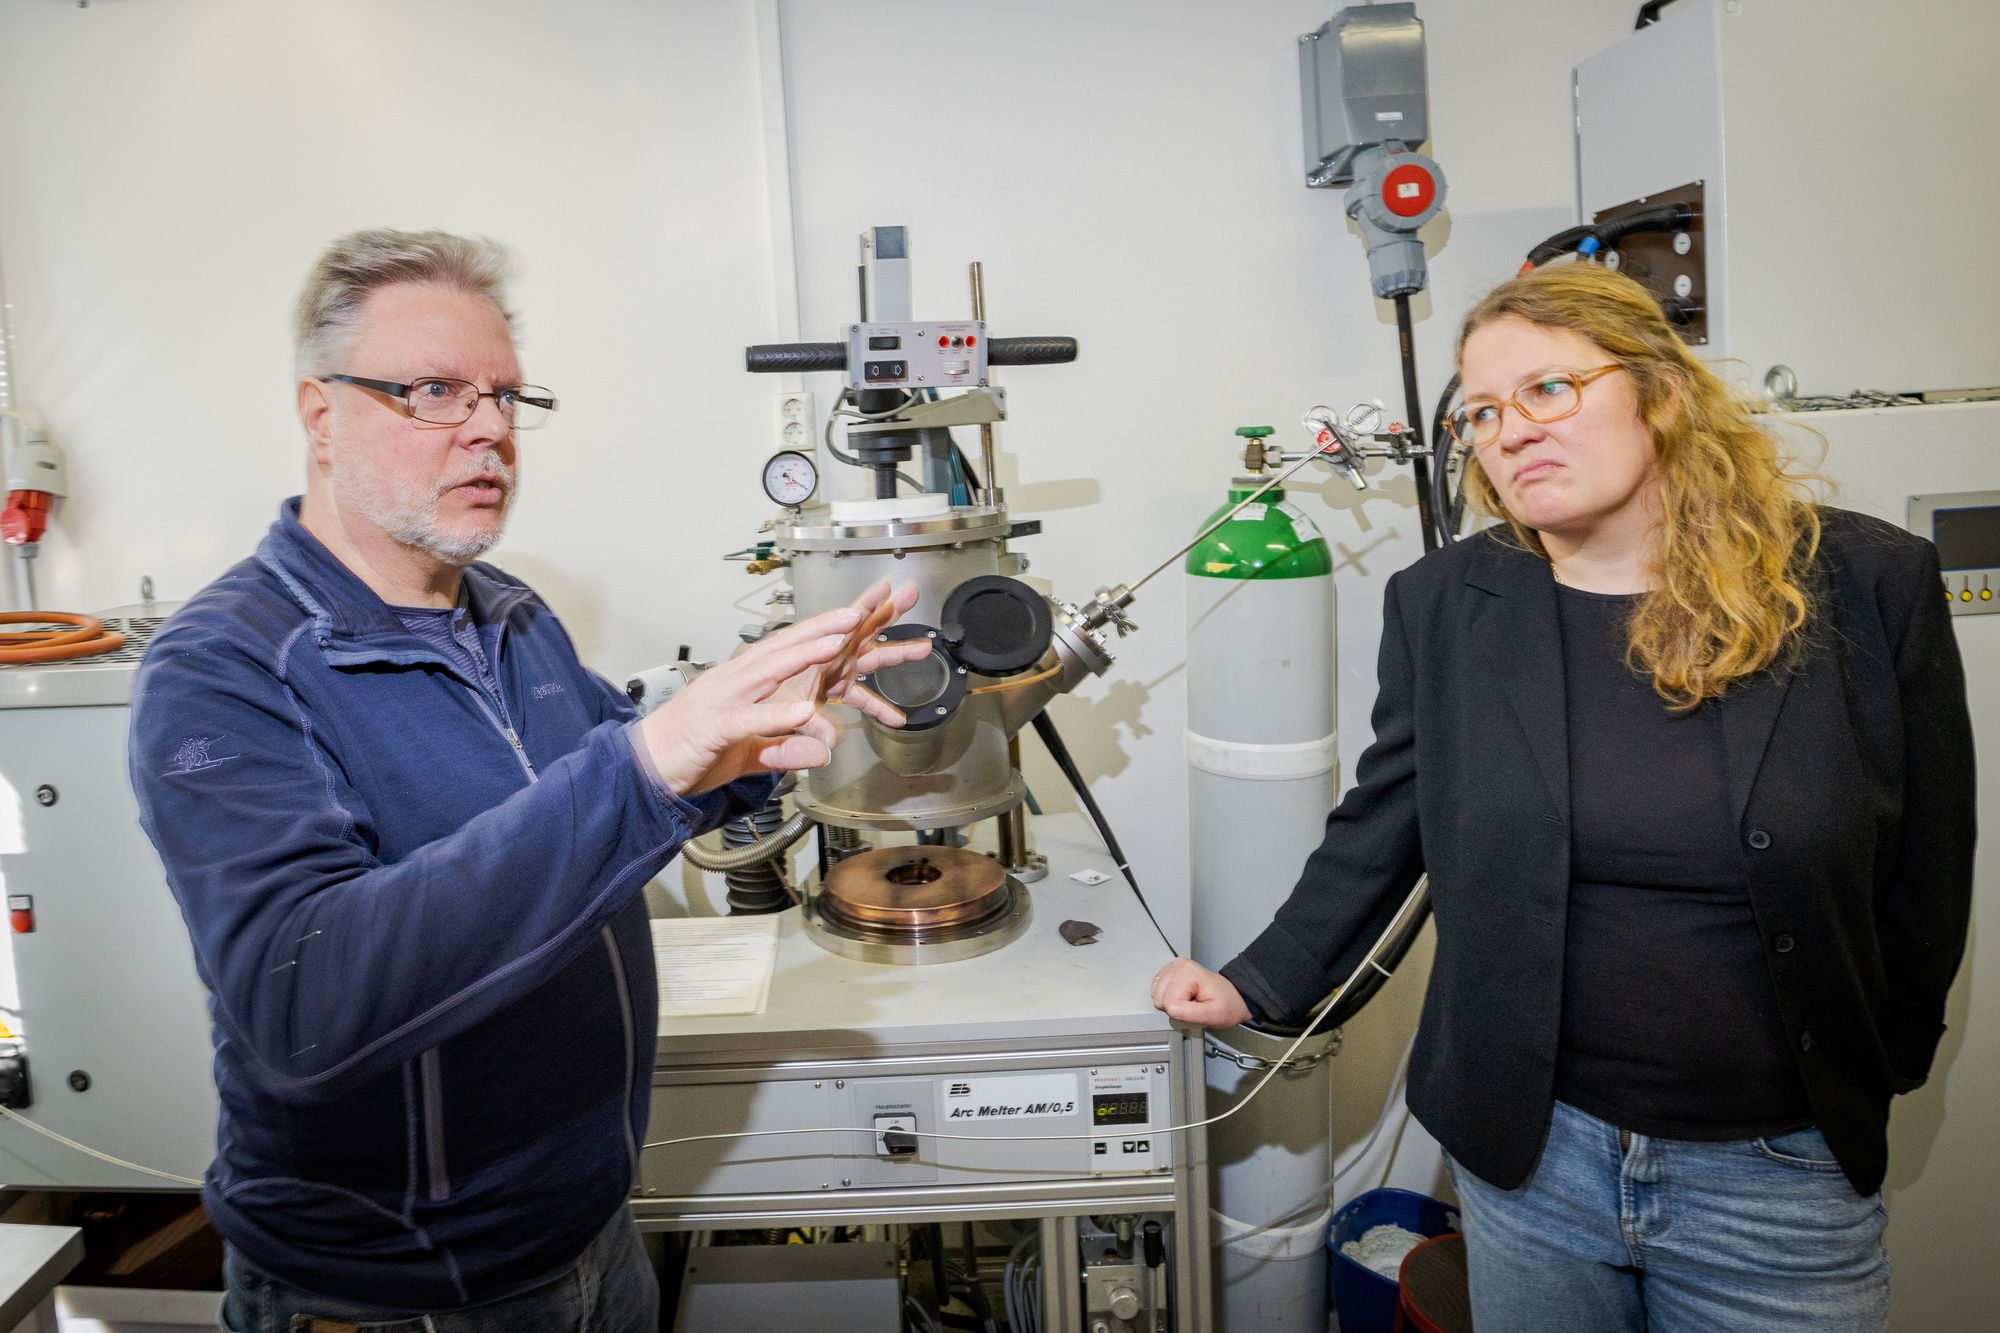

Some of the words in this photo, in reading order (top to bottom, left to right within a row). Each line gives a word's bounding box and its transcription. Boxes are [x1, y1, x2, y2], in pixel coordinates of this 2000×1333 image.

[950, 1107, 974, 1118] Arc
[977, 1105, 1022, 1117] Melter
[1024, 1101, 1075, 1115] AM/0,5
